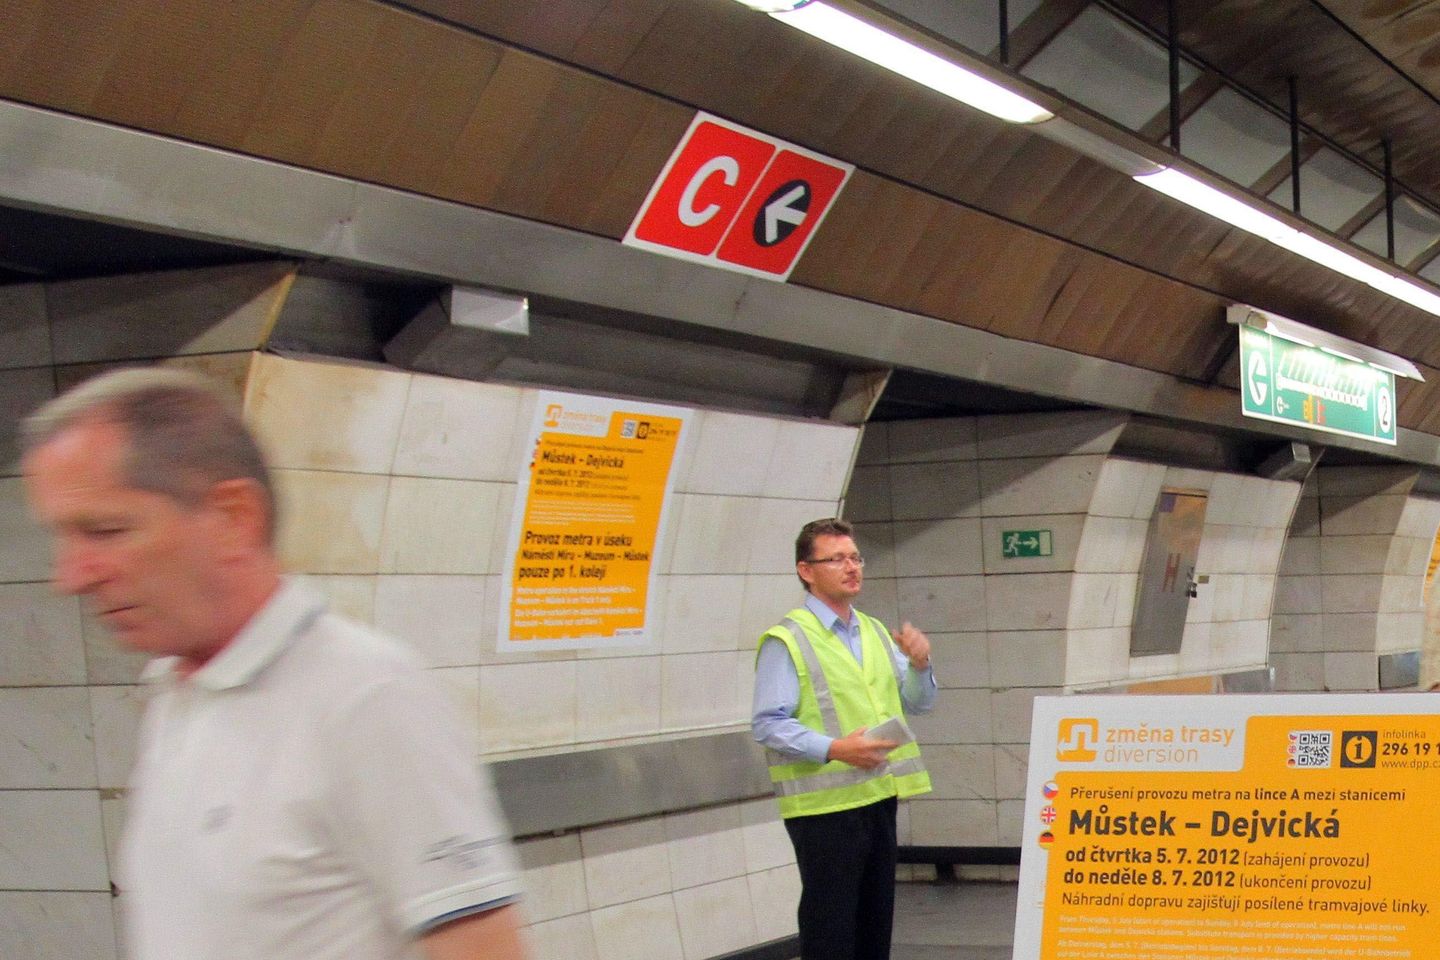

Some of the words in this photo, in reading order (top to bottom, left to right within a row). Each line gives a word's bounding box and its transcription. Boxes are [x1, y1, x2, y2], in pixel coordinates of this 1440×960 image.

[677, 155, 740, 227] C
[1105, 723, 1174, 743] změna
[1181, 725, 1235, 747] trasy
[1382, 729, 1426, 739] infolinka
[1104, 746, 1200, 764] diversion
[1382, 743, 1408, 756] 296
[1414, 743, 1431, 756] 19
[1070, 786, 1134, 800] Přerušení
[1138, 789, 1188, 802] provozu
[1192, 788, 1231, 800] metra
[1235, 790, 1250, 800] na
[1254, 788, 1287, 801] lince
[1290, 789, 1300, 801] A
[1304, 788, 1336, 801] mezi
[1339, 788, 1406, 801] stanicemi
[1068, 804, 1176, 836] Můstek
[1211, 808, 1340, 844] Dejvická
[1065, 847, 1086, 863] od
[1090, 845, 1152, 863] čtvrtka
[1156, 849, 1172, 864] 5.
[1177, 848, 1192, 865] 7.
[1196, 849, 1240, 866] 2012
[1243, 850, 1306, 869] (zahájení
[1309, 853, 1370, 870] provozu)
[1064, 868, 1084, 885] do
[1089, 868, 1147, 885] neděle
[1151, 870, 1167, 886] 8.
[1172, 870, 1188, 886] 7.
[1192, 870, 1236, 887] 2012
[1239, 872, 1307, 889] (ukončení
[1311, 875, 1372, 892] provozu)
[1062, 892, 1125, 906] Náhradní
[1128, 894, 1183, 910] dopravu
[1187, 894, 1241, 912] zajišťují
[1245, 896, 1304, 911] posílené
[1308, 898, 1388, 915] tramvajové
[1392, 899, 1430, 917] linky.
